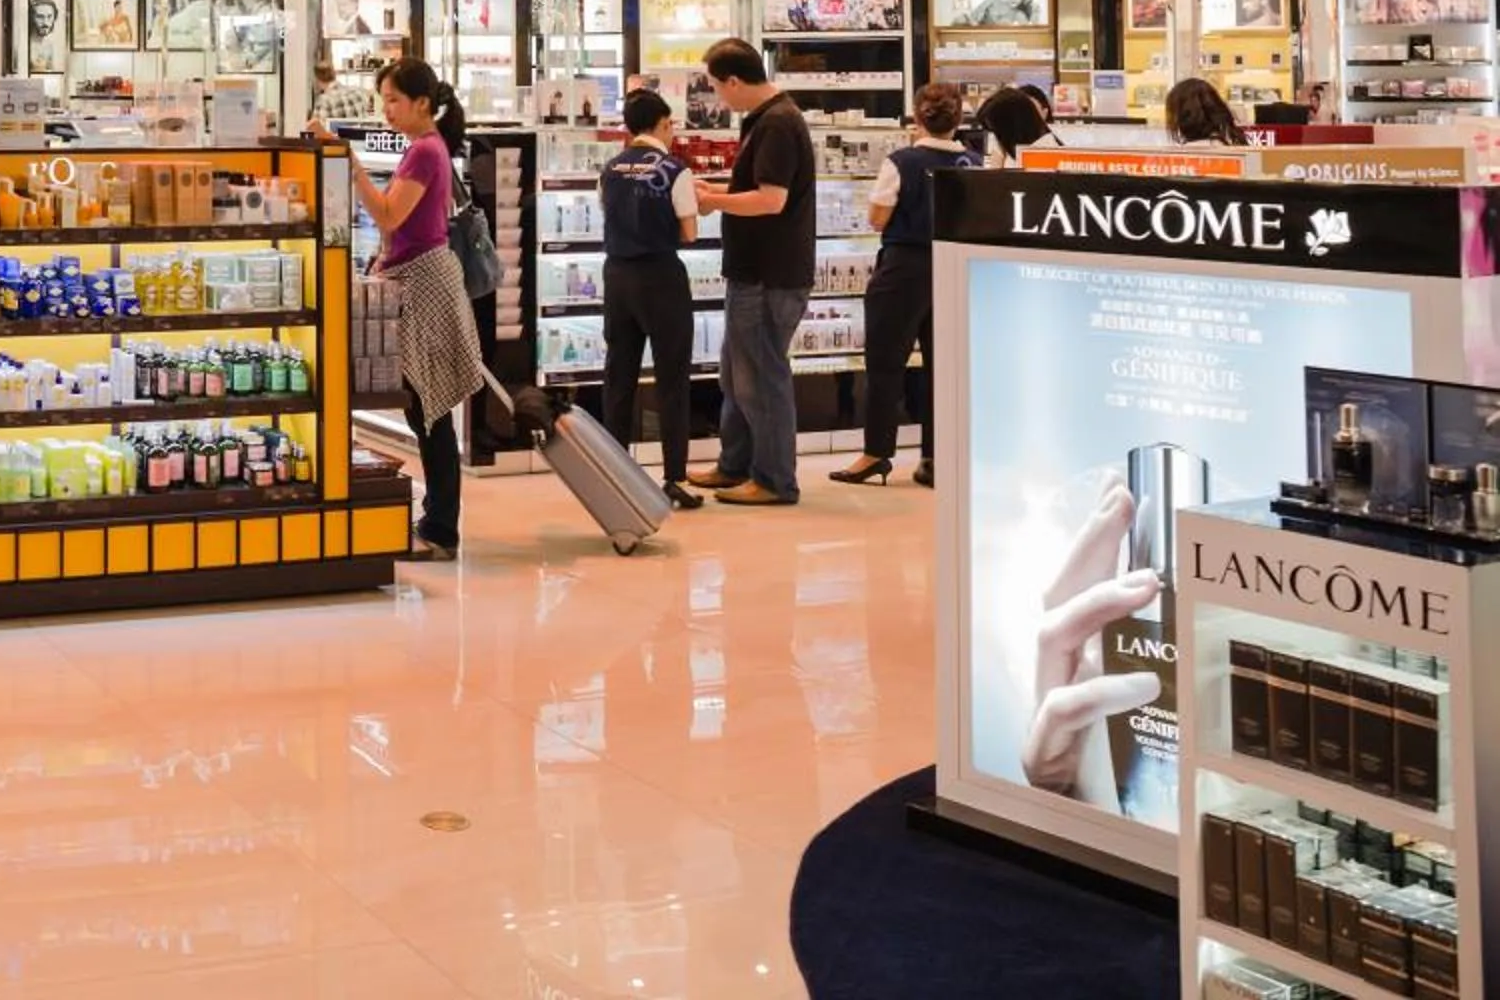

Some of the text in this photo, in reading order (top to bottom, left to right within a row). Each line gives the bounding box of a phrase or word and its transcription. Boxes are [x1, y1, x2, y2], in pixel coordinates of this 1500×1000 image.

[1308, 162, 1388, 181] ORIGINS
[1011, 189, 1286, 251] LANCÔME
[1193, 541, 1452, 637] LANCÔME
[1116, 633, 1178, 662] LANC
[1141, 705, 1178, 722] ADVAN
[1129, 715, 1179, 741] GÉNIFI
